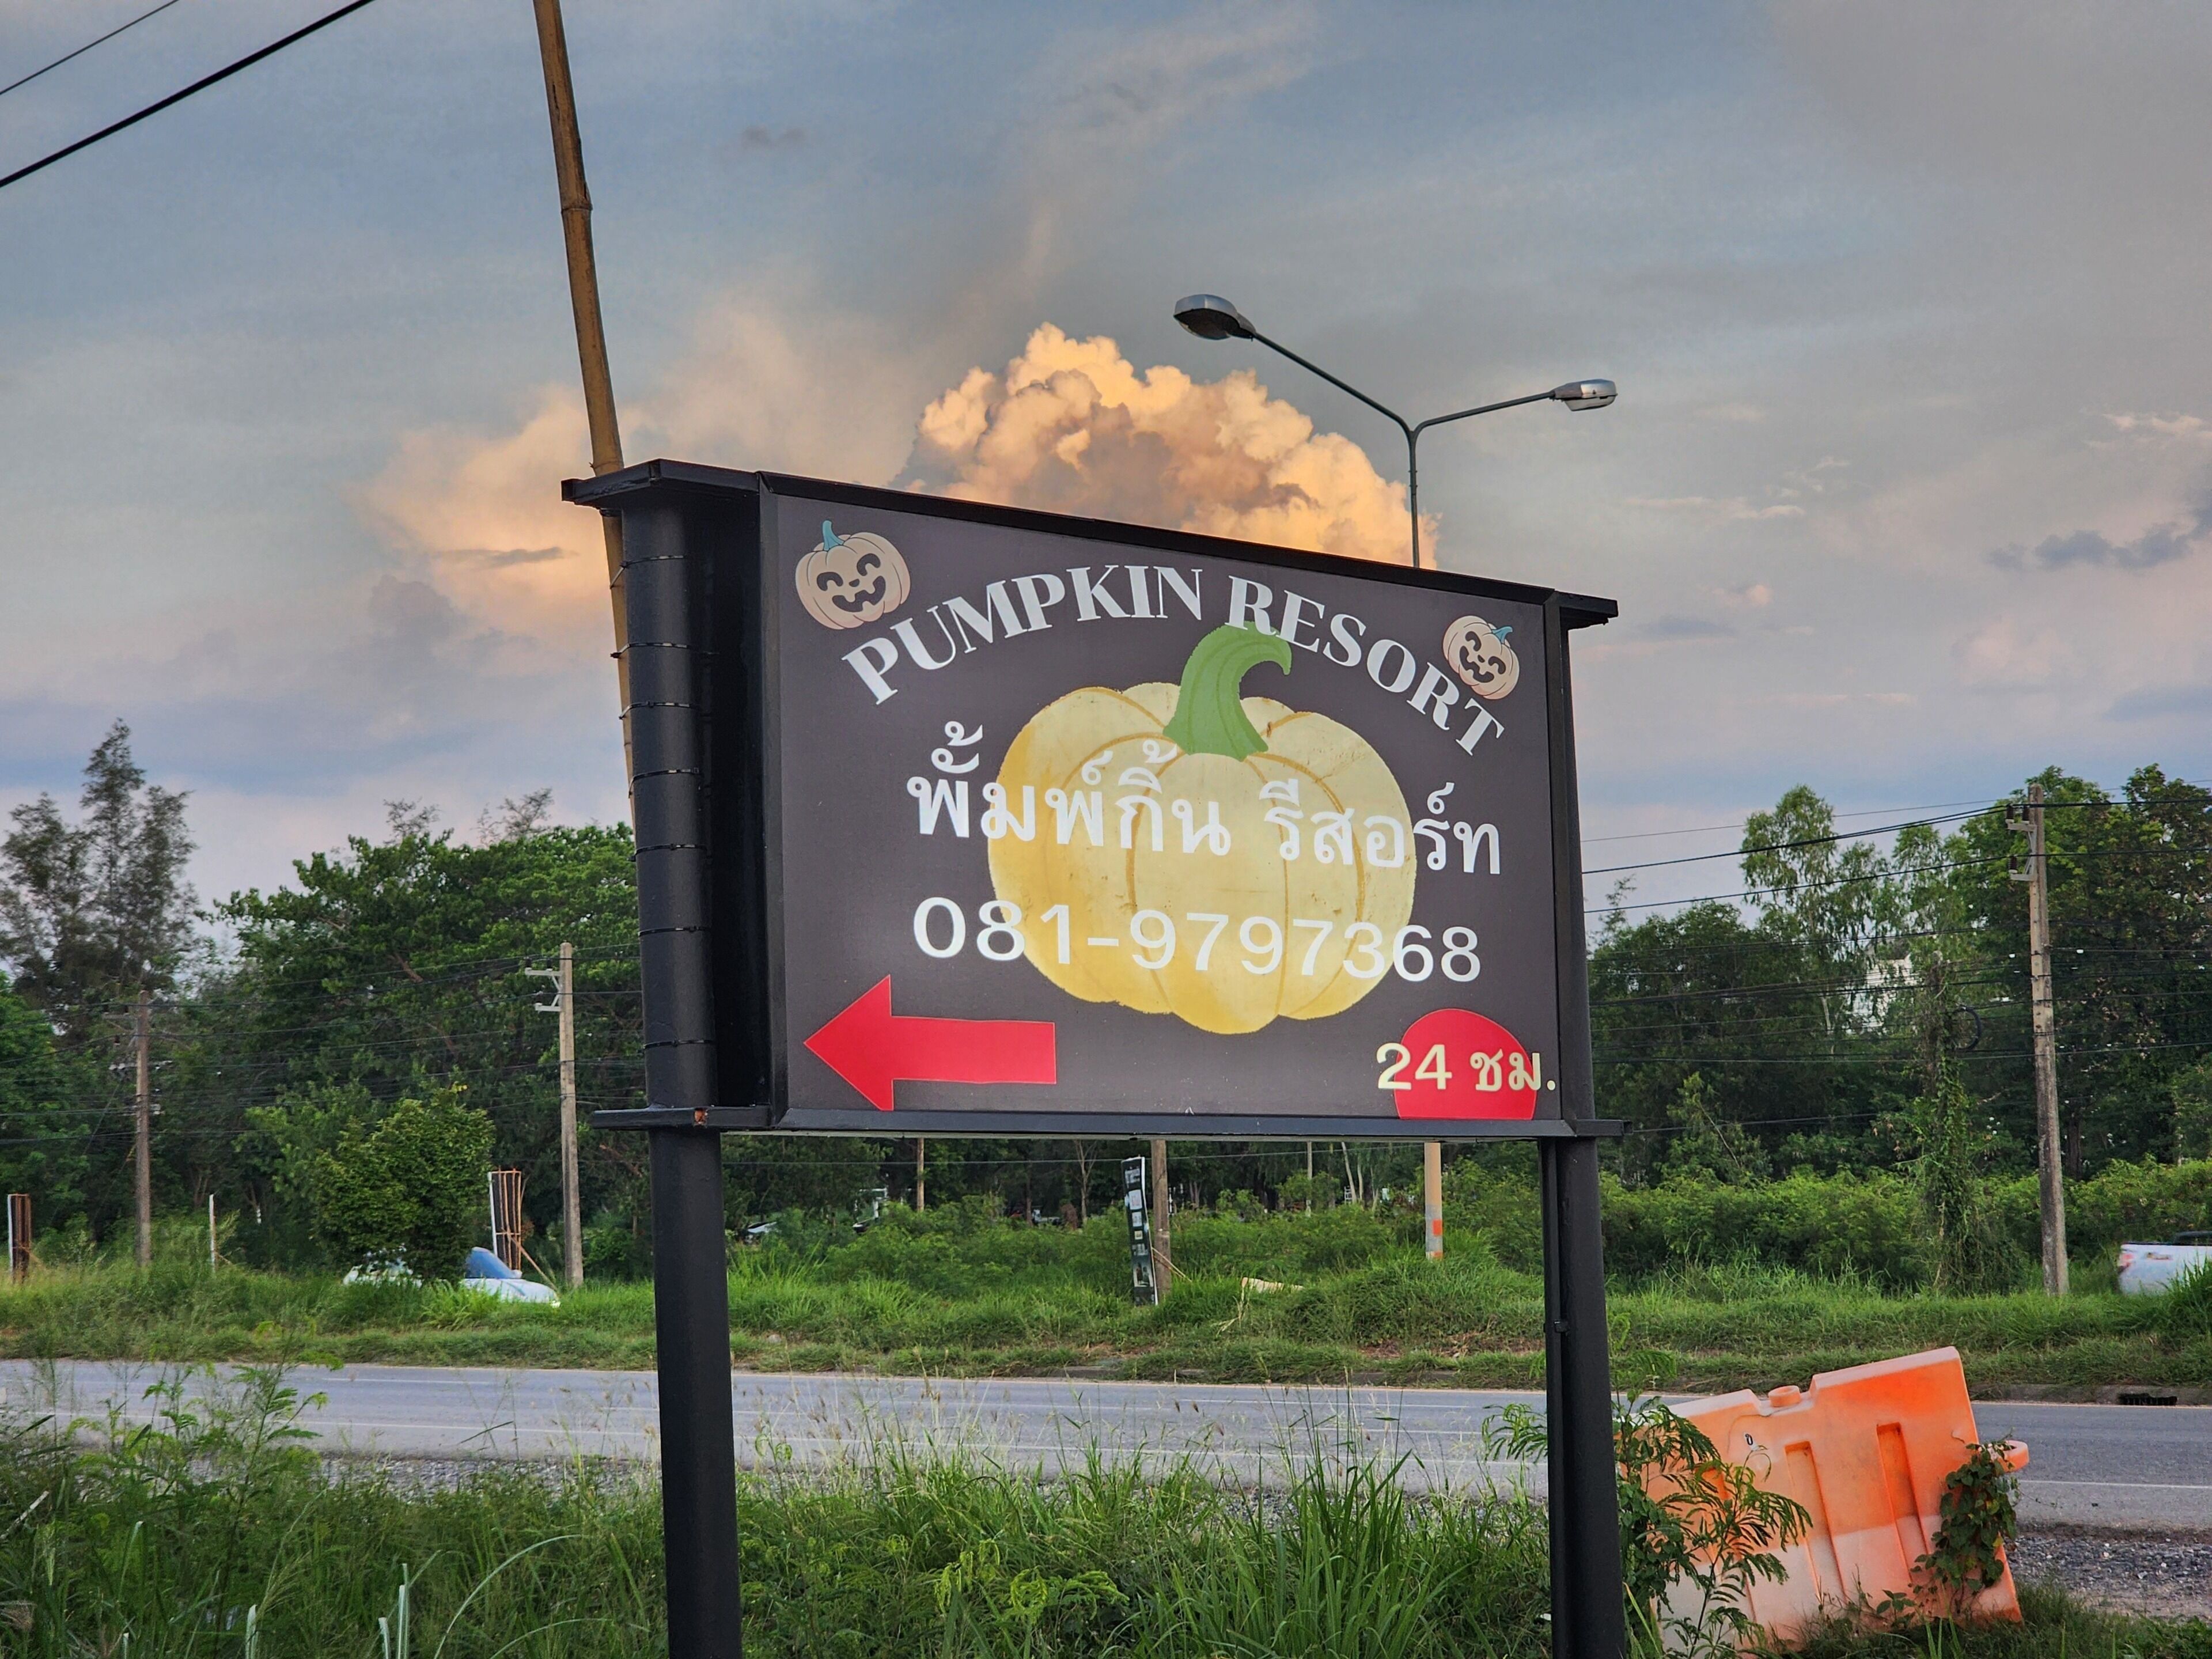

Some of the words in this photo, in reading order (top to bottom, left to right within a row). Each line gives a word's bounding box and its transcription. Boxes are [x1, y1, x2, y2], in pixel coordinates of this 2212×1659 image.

[841, 565, 1203, 705] PUMPKIN
[1224, 575, 1505, 756] RESORT
[1259, 778, 1501, 874] รีสอร์ท
[913, 897, 1481, 983] 081-9797368
[1376, 1042, 1452, 1090] 24
[1469, 1048, 1556, 1092] ชม.
